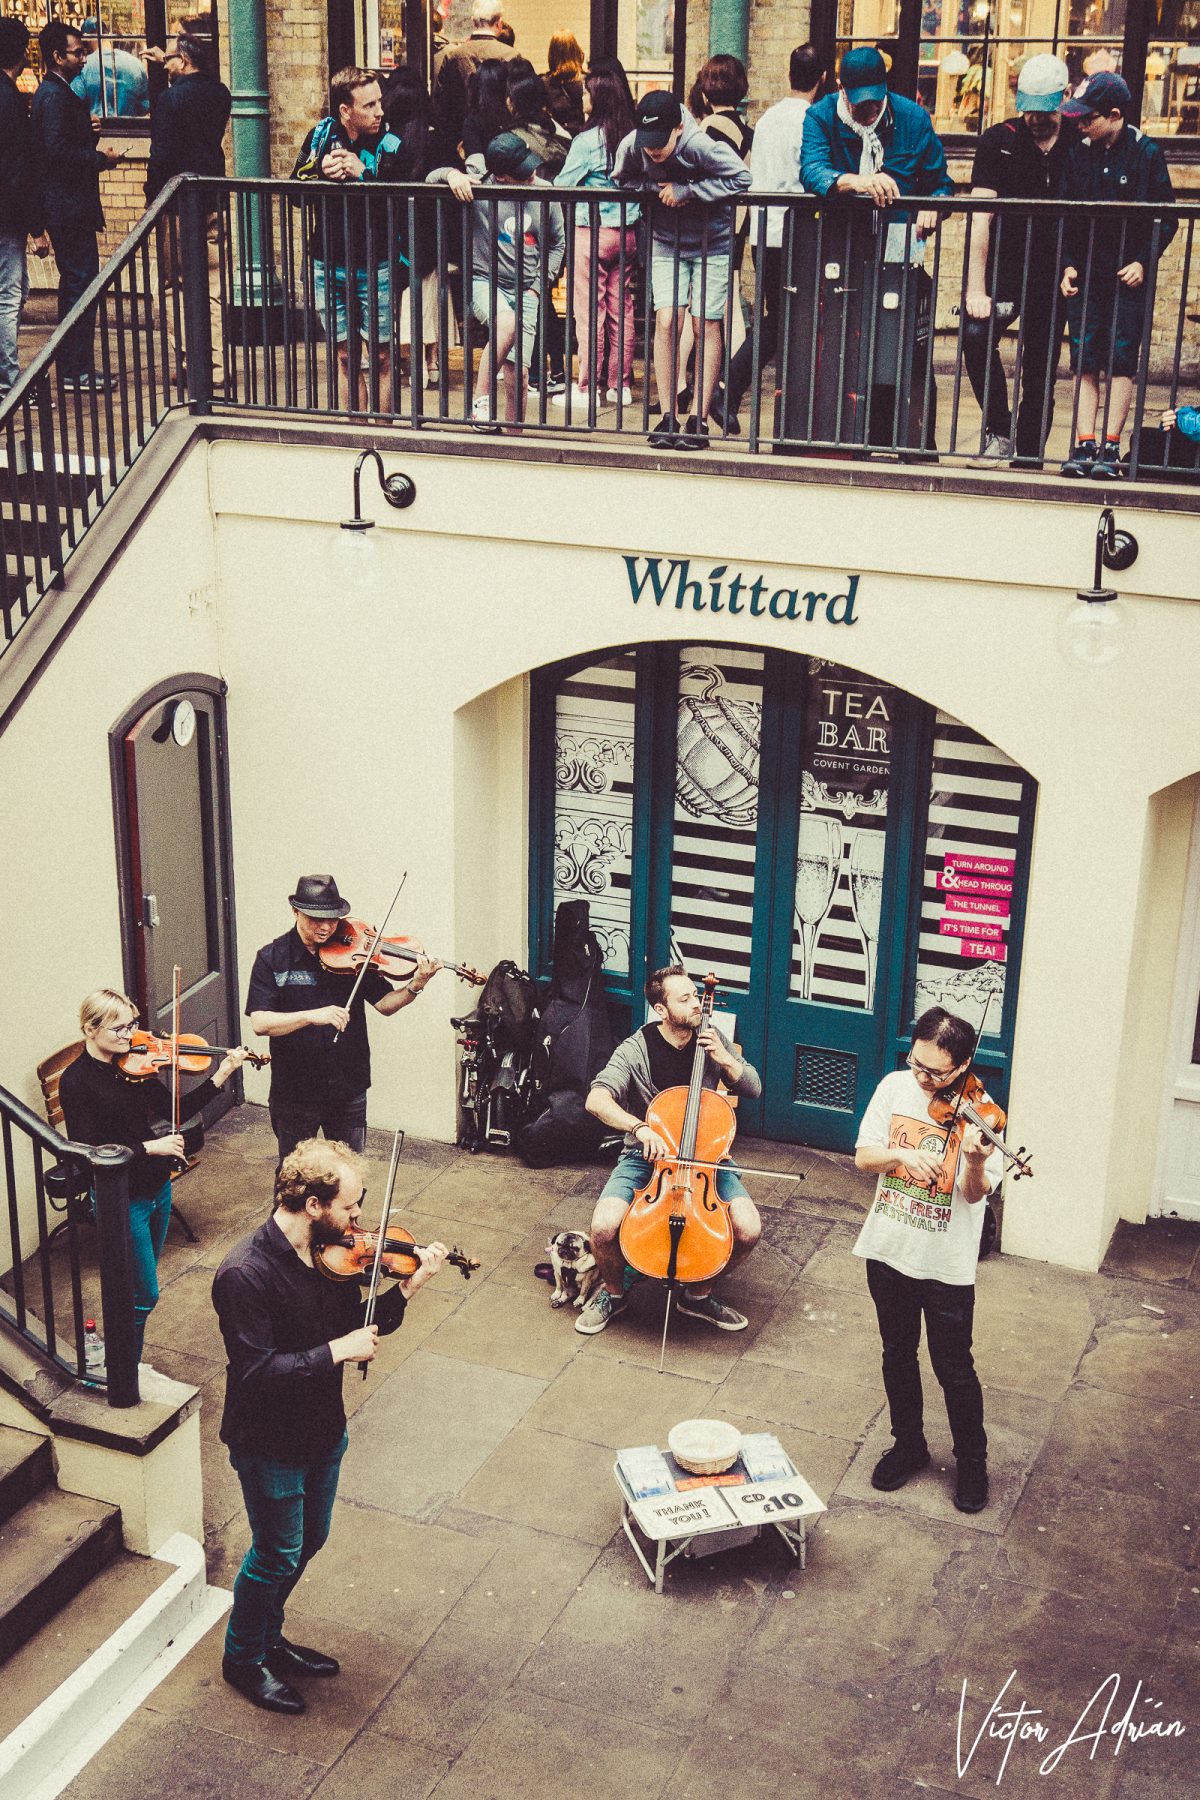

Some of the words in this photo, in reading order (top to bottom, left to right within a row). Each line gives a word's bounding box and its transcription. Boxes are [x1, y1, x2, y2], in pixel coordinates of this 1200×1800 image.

[621, 555, 860, 626] Whittard
[822, 689, 890, 721] TEA
[817, 721, 890, 754] BAR
[813, 759, 850, 770] COVENT
[853, 763, 890, 775] GARDEN
[952, 859, 973, 869] TURN
[974, 863, 1008, 873] AROUND
[941, 865, 960, 889] &
[958, 879, 979, 889] HEAD
[981, 881, 1012, 892] THROUG
[953, 900, 968, 909] THE
[970, 902, 1000, 912] TUNNEL
[943, 923, 958, 932] IT'S
[960, 925, 979, 935] TIME
[981, 927, 999, 936] FOR
[969, 942, 996, 957] TEA!
[910, 1199, 952, 1223] FRESH
[652, 1499, 707, 1517] THANK
[741, 1492, 766, 1504] CD
[763, 1492, 804, 1514] £10
[668, 1508, 711, 1526] YOU!
